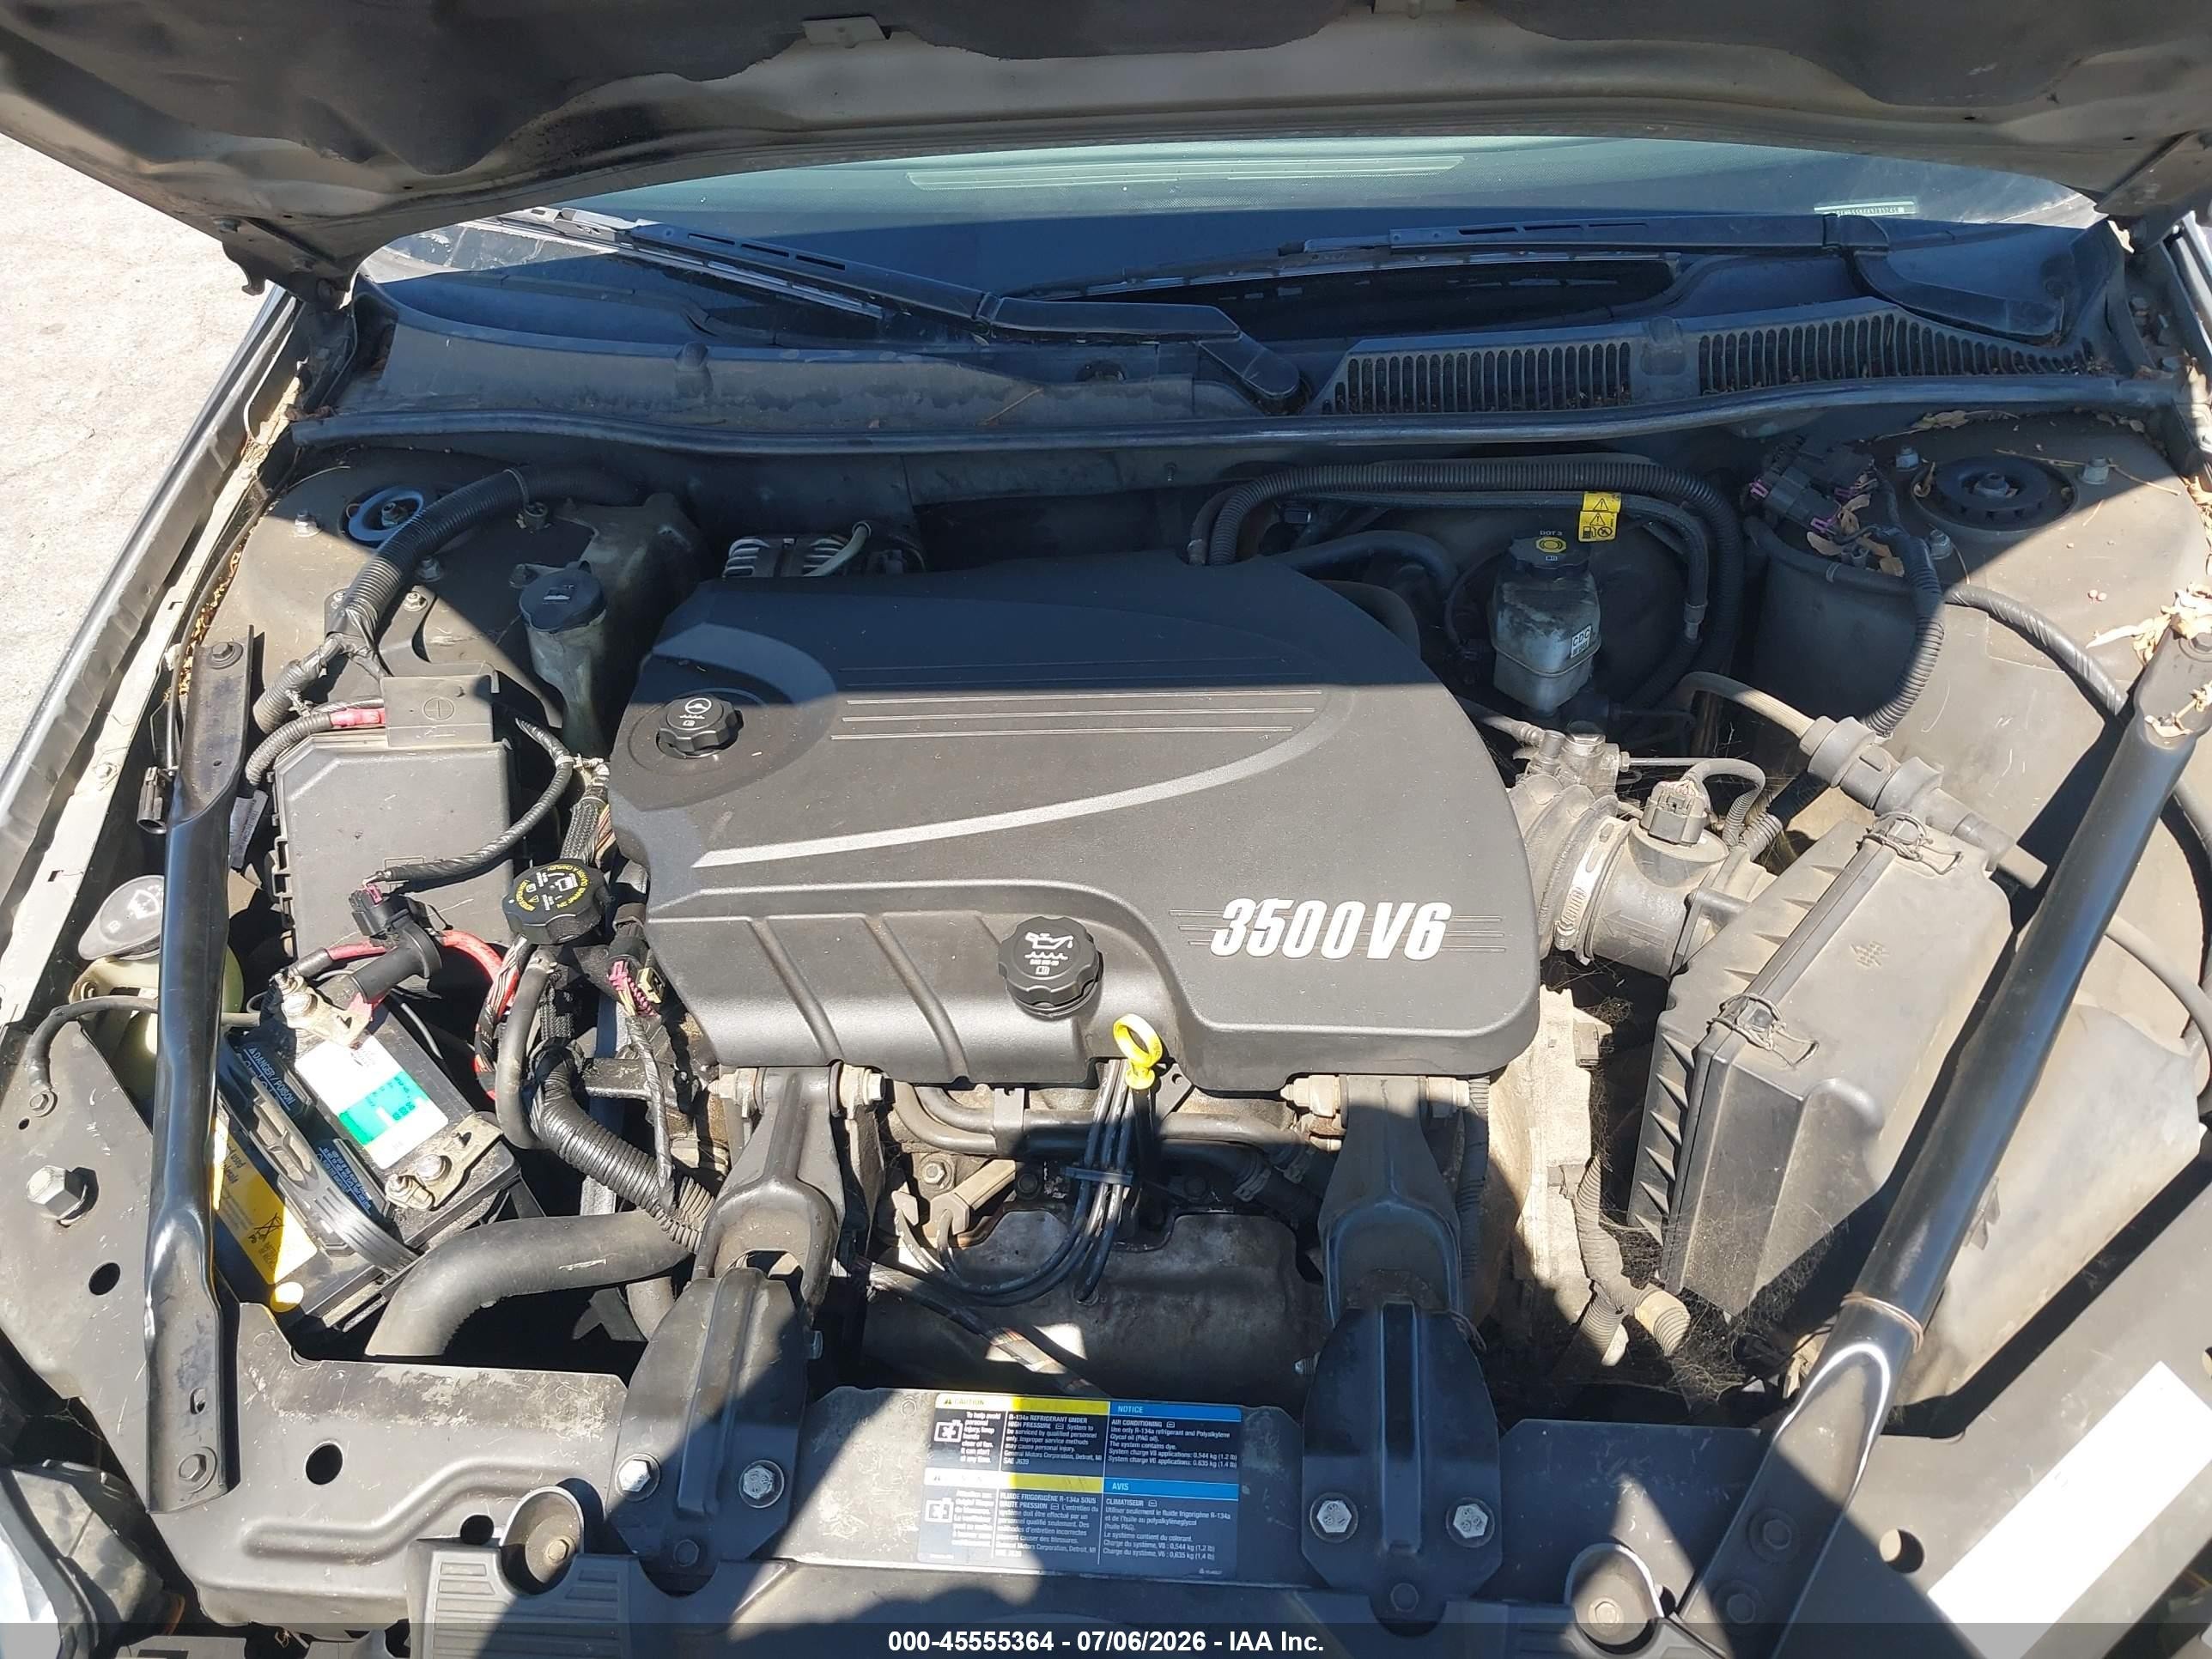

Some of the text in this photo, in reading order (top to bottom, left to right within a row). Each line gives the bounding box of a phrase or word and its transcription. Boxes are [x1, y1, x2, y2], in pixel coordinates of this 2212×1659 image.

[1573, 629, 1589, 646] CDC
[1210, 898, 1452, 960] 3500 V6
[252, 1050, 276, 1079] DANGER
[273, 1079, 295, 1106] POISON
